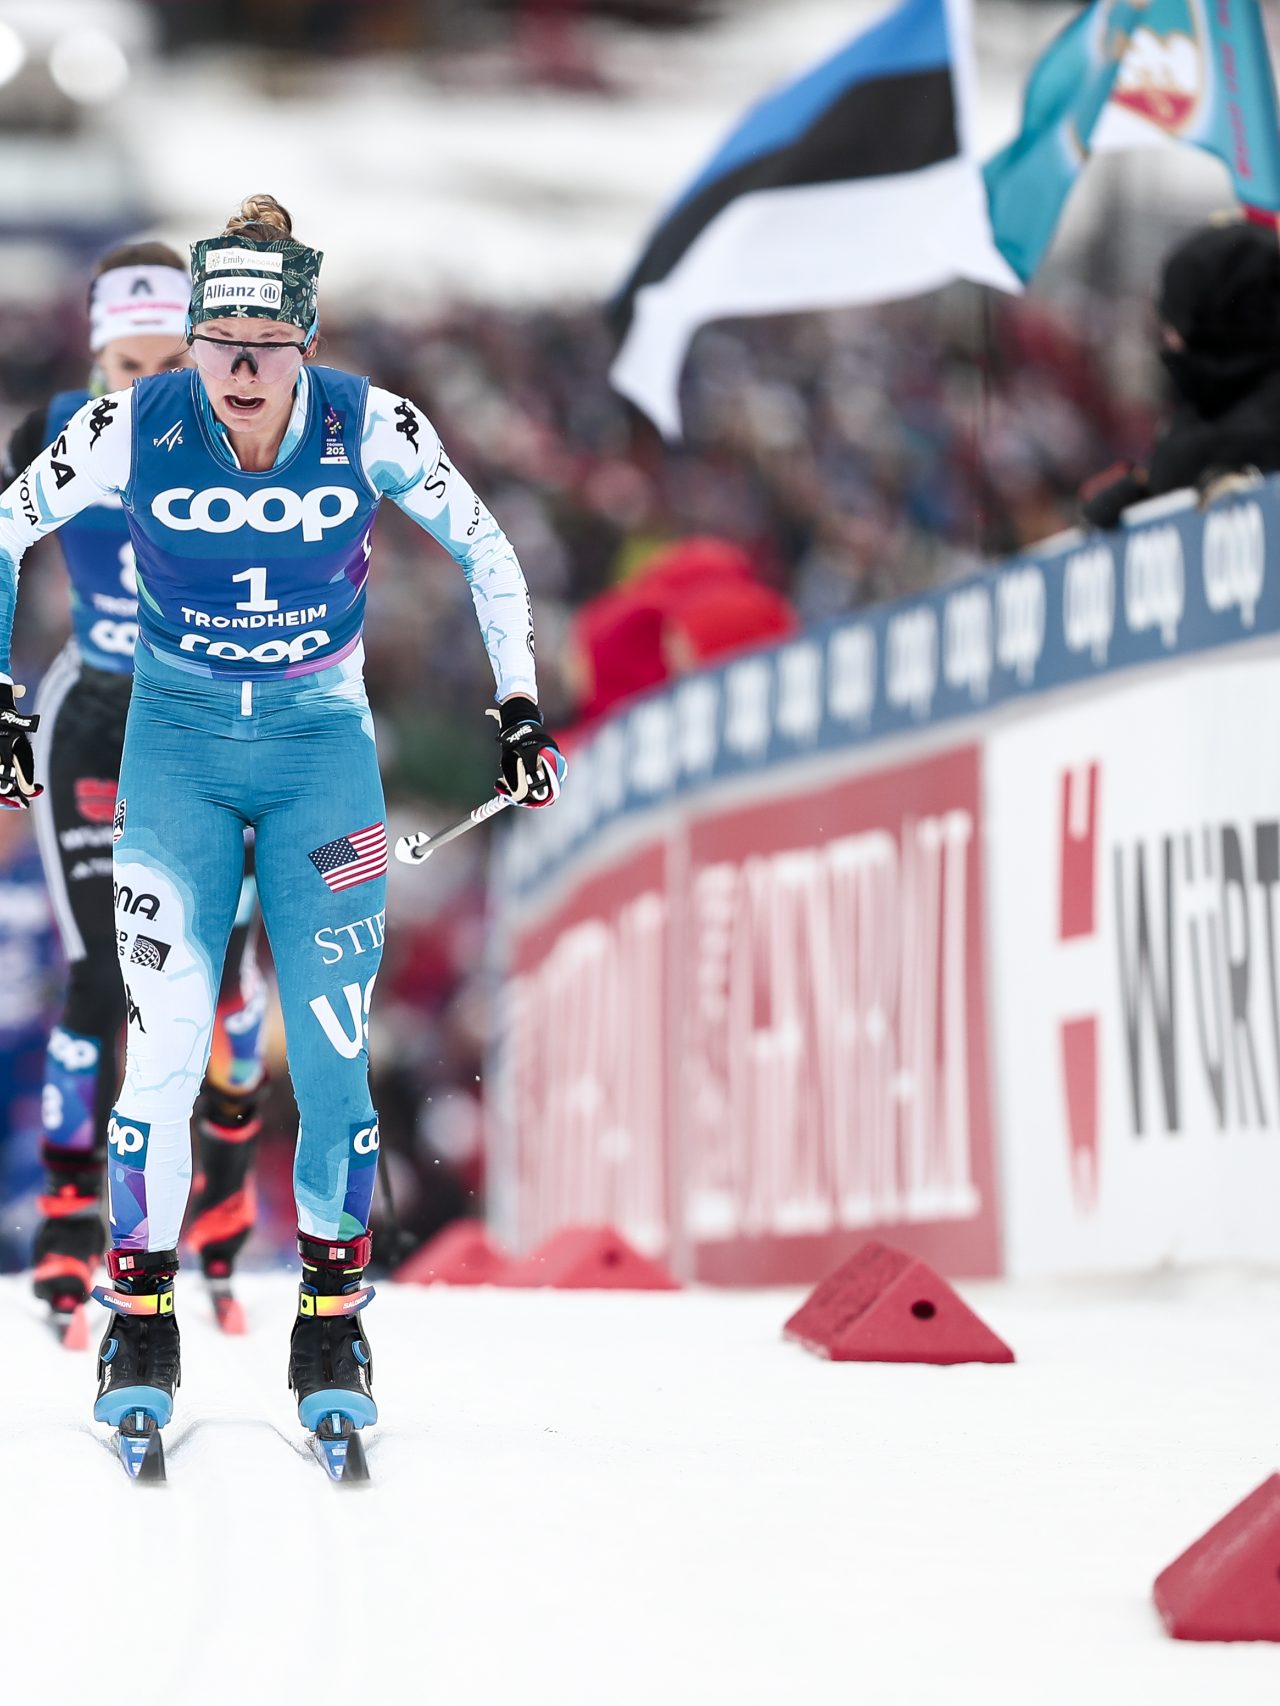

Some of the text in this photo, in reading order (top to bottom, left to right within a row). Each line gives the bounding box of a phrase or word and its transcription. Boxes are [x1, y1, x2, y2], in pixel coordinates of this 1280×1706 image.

[223, 256, 245, 265] Emily
[205, 284, 255, 300] Allianz
[50, 430, 76, 490] SA
[326, 446, 345, 455] 202
[151, 486, 359, 542] coop
[232, 567, 278, 612] 1
[181, 604, 327, 628] TRONDHEIM
[1113, 820, 1280, 1136] WÜRT
[104, 1295, 132, 1308] SALOMON
